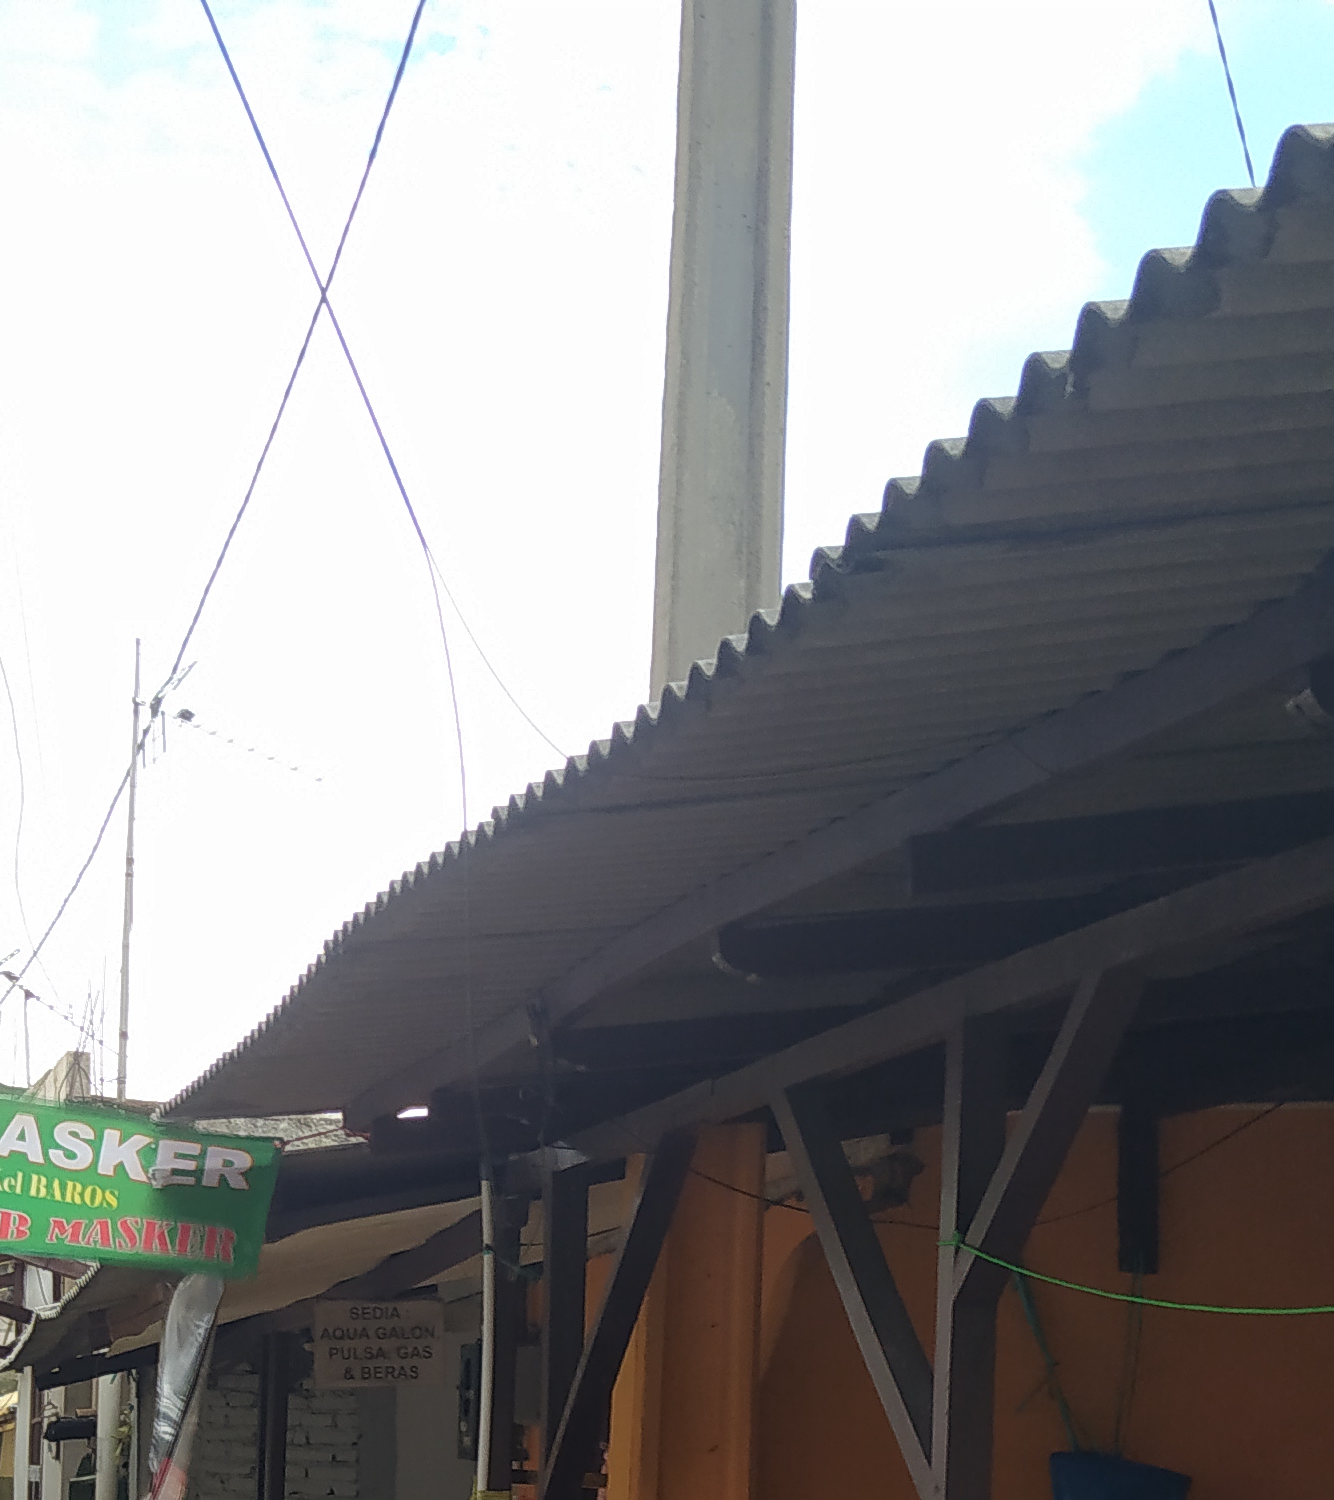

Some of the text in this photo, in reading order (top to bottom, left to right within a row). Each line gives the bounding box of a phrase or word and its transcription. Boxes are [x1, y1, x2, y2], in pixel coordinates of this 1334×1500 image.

[29, 1173, 119, 1210] BAROS
[46, 1216, 236, 1263] MASKER
[350, 1307, 400, 1320] SEDIA
[320, 1327, 370, 1341] AQUA
[396, 1345, 434, 1360] GAS
[360, 1366, 420, 1380] BERAS
